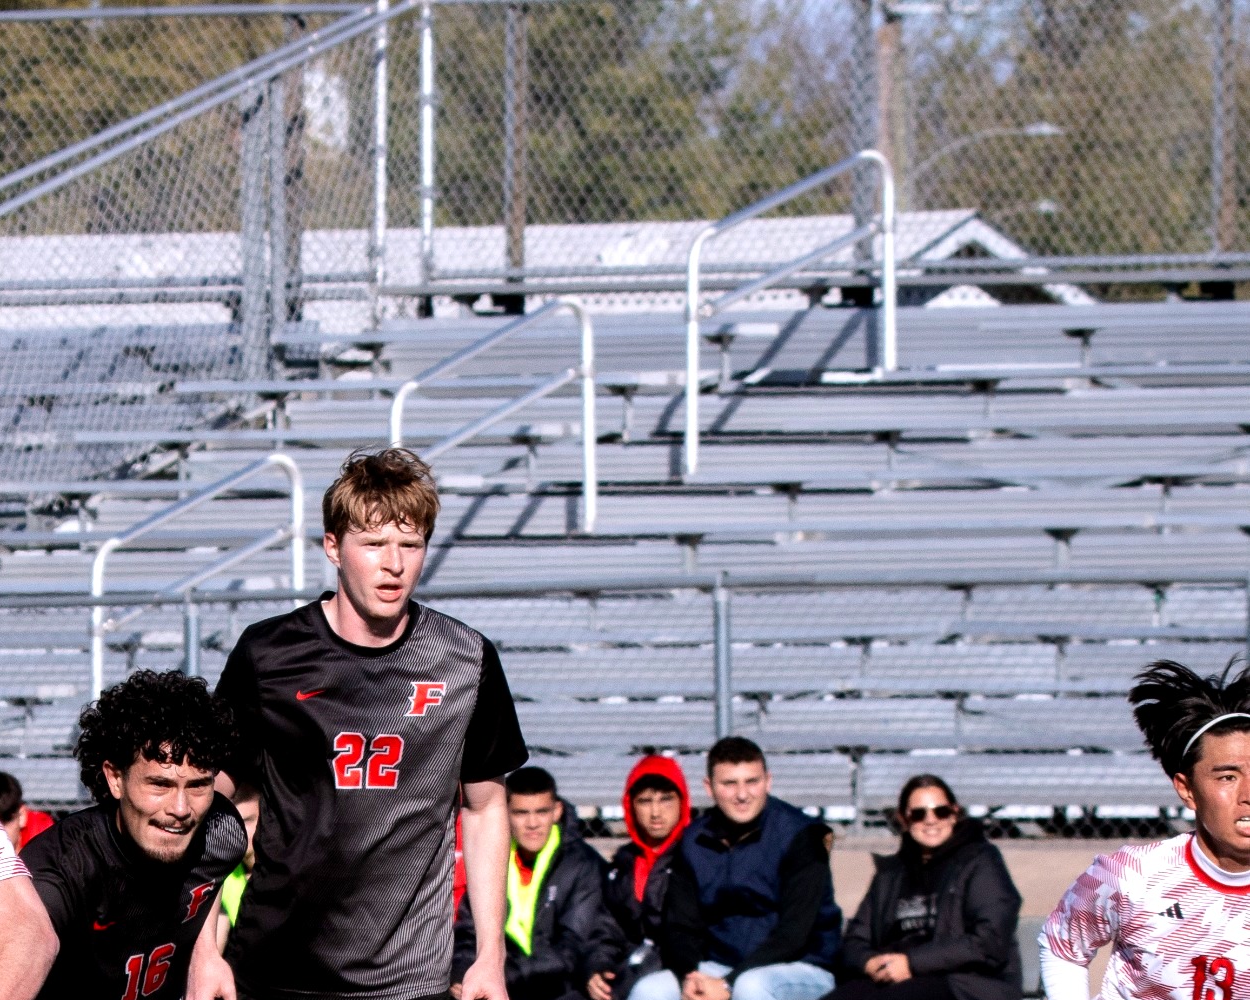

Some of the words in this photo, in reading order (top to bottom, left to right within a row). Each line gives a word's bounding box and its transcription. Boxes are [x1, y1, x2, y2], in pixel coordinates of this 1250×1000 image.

[404, 682, 447, 717] F
[332, 732, 405, 790] 22
[181, 879, 216, 924] F
